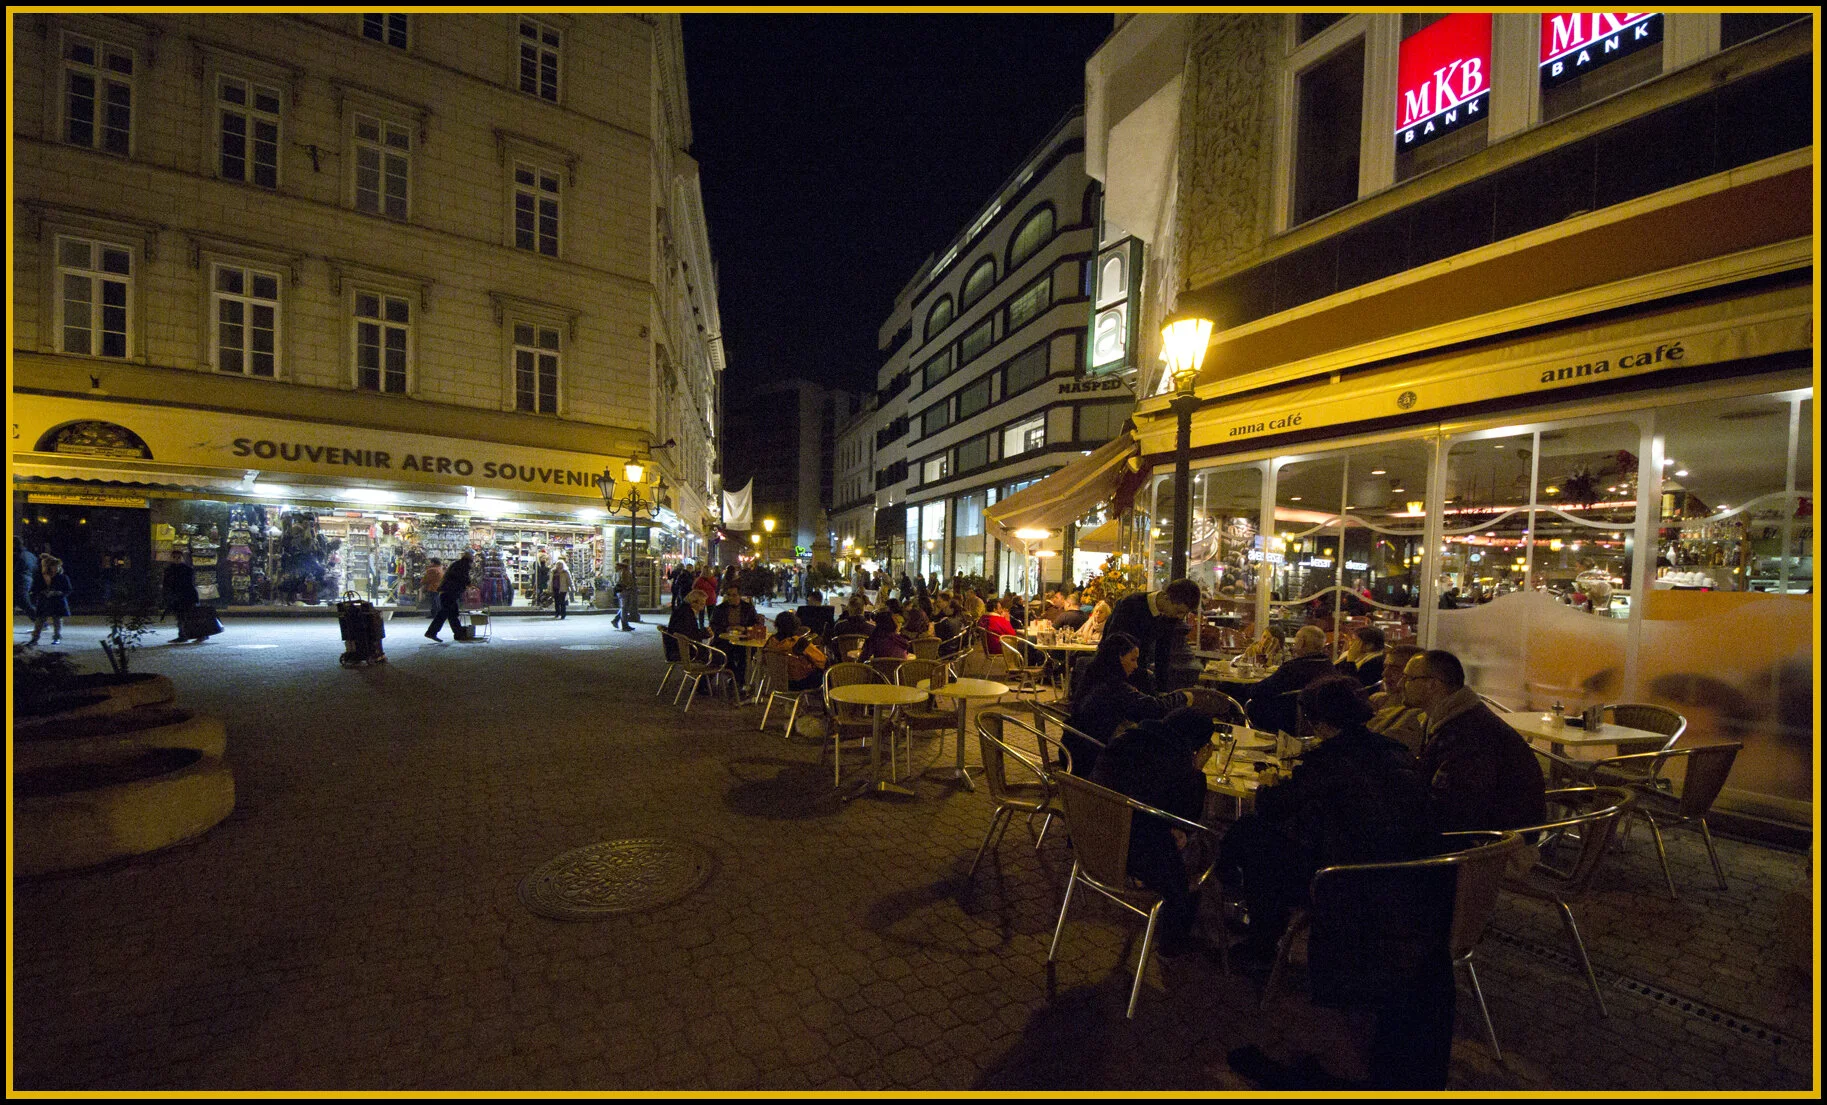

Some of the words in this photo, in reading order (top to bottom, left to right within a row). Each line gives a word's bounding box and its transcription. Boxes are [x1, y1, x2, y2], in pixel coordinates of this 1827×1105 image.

[1551, 22, 1649, 77] BANK
[1402, 57, 1484, 126] MKB
[1404, 99, 1480, 144] BANK
[1540, 359, 1610, 384] anna
[1618, 341, 1685, 369] café
[1058, 378, 1122, 395] MASPED
[1229, 421, 1265, 437] anna
[1268, 412, 1303, 430] café
[232, 437, 392, 470] SOUVENIR
[402, 453, 474, 477] AERO
[483, 461, 604, 489] SOUVENIR
